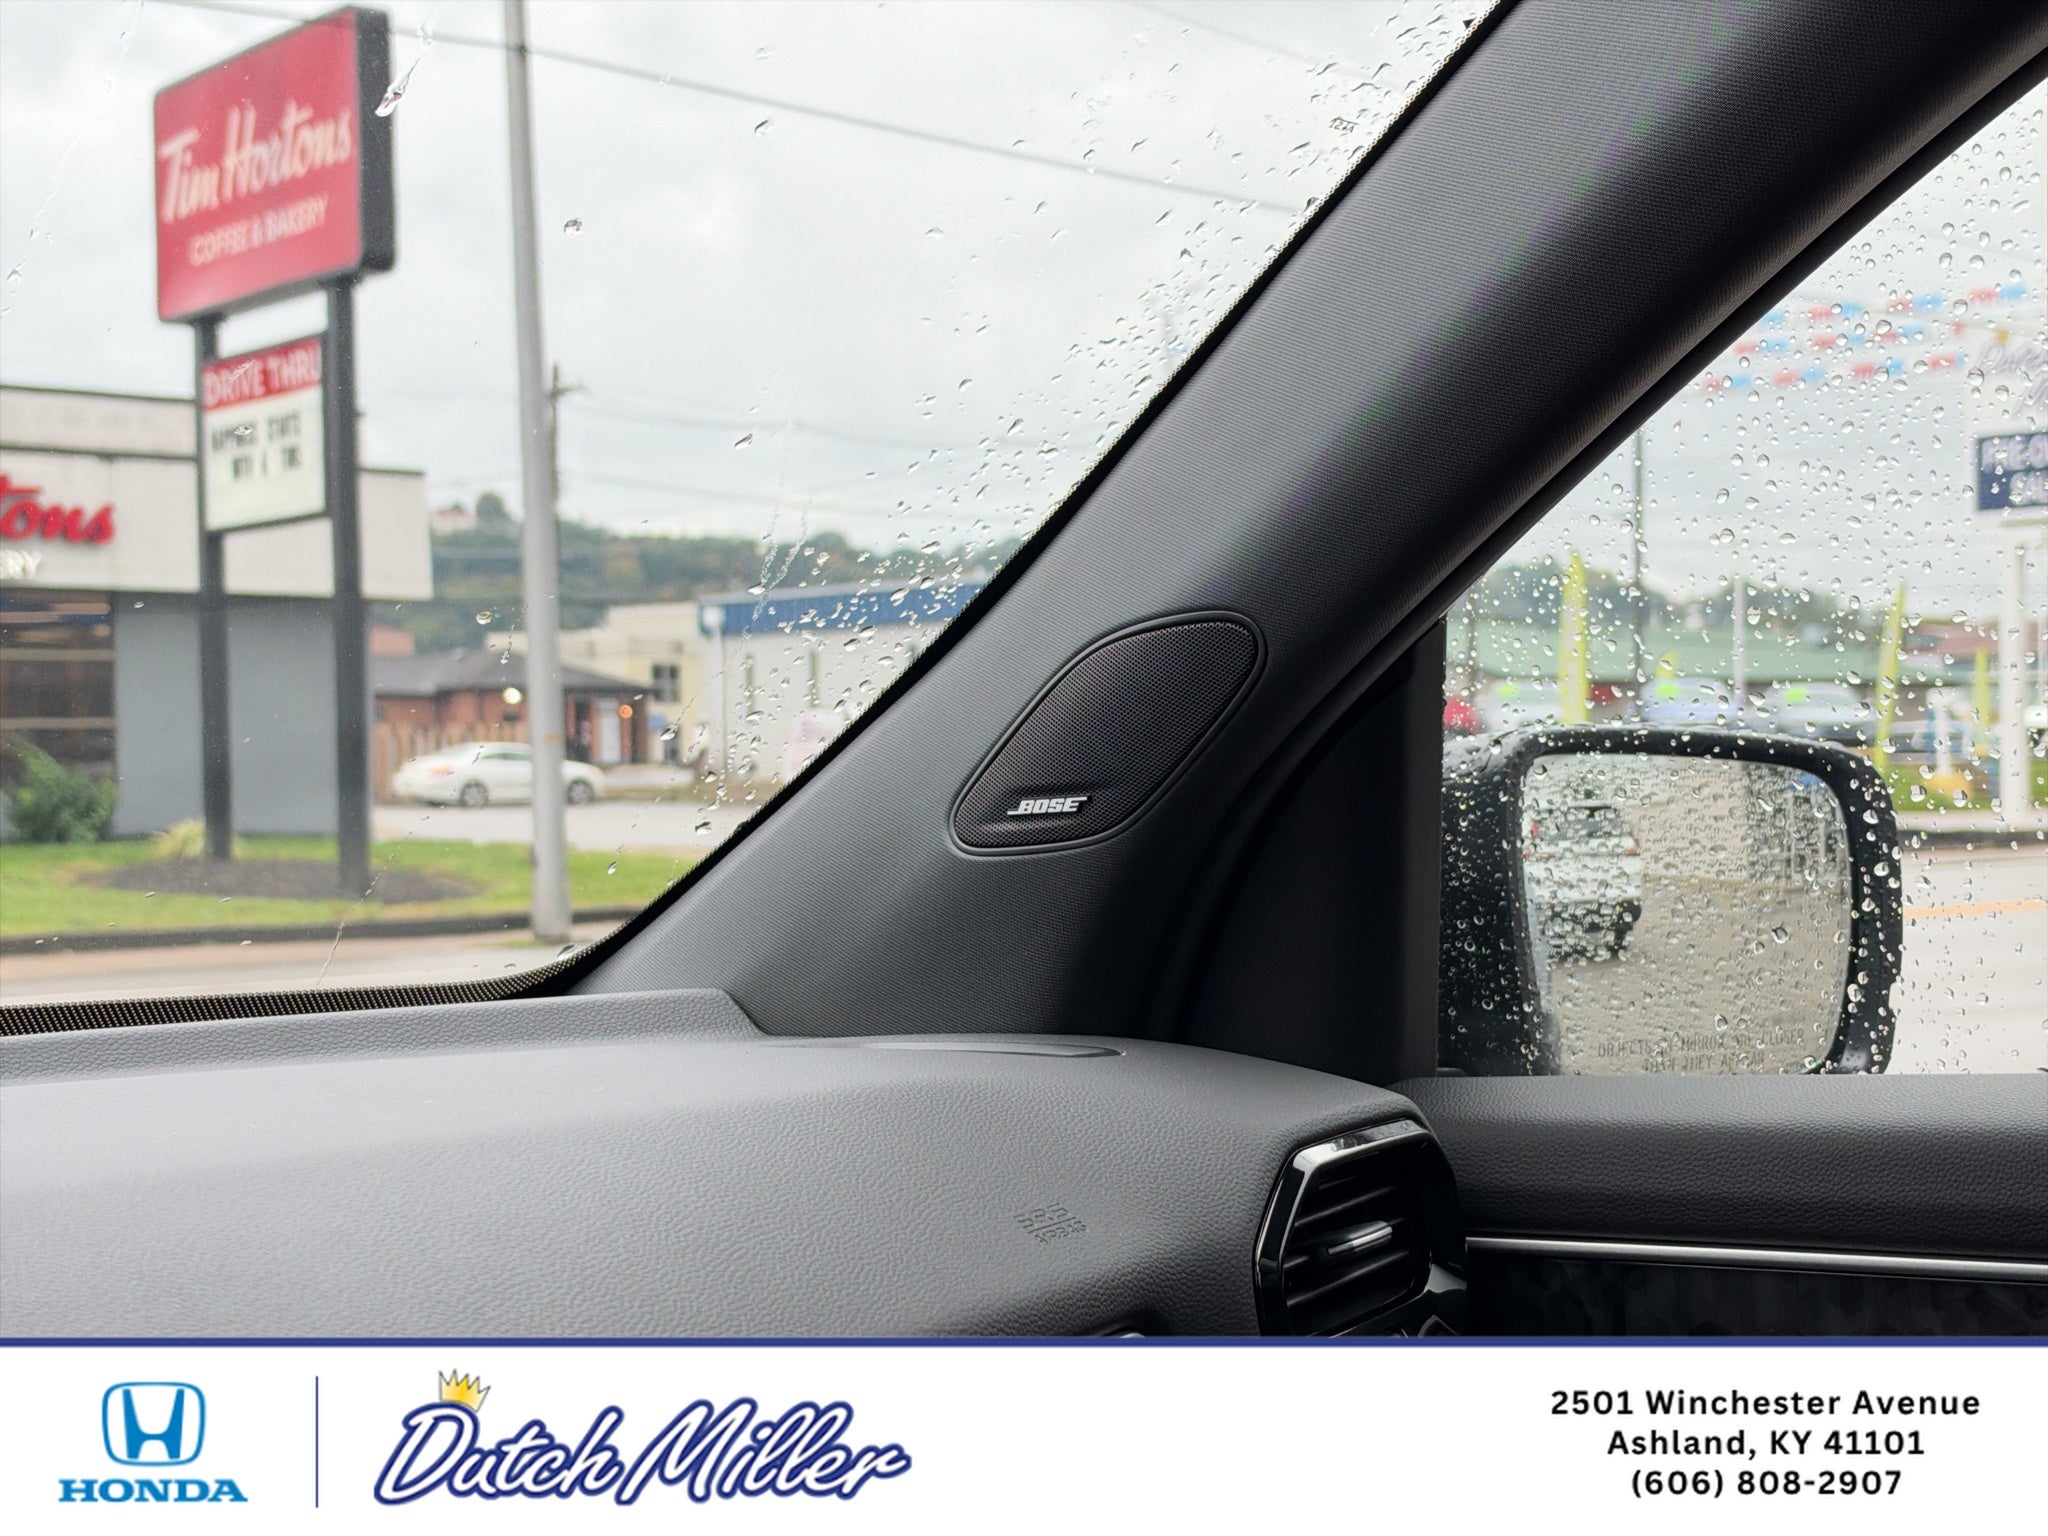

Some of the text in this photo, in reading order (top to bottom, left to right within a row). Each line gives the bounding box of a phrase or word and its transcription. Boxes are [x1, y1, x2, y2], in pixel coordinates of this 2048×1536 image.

[160, 99, 352, 223] Tim Hortons
[189, 219, 248, 265] COFFEE
[263, 193, 329, 243] BAKERY
[203, 359, 266, 407] DRIVE
[1006, 796, 1088, 816] BOSE
